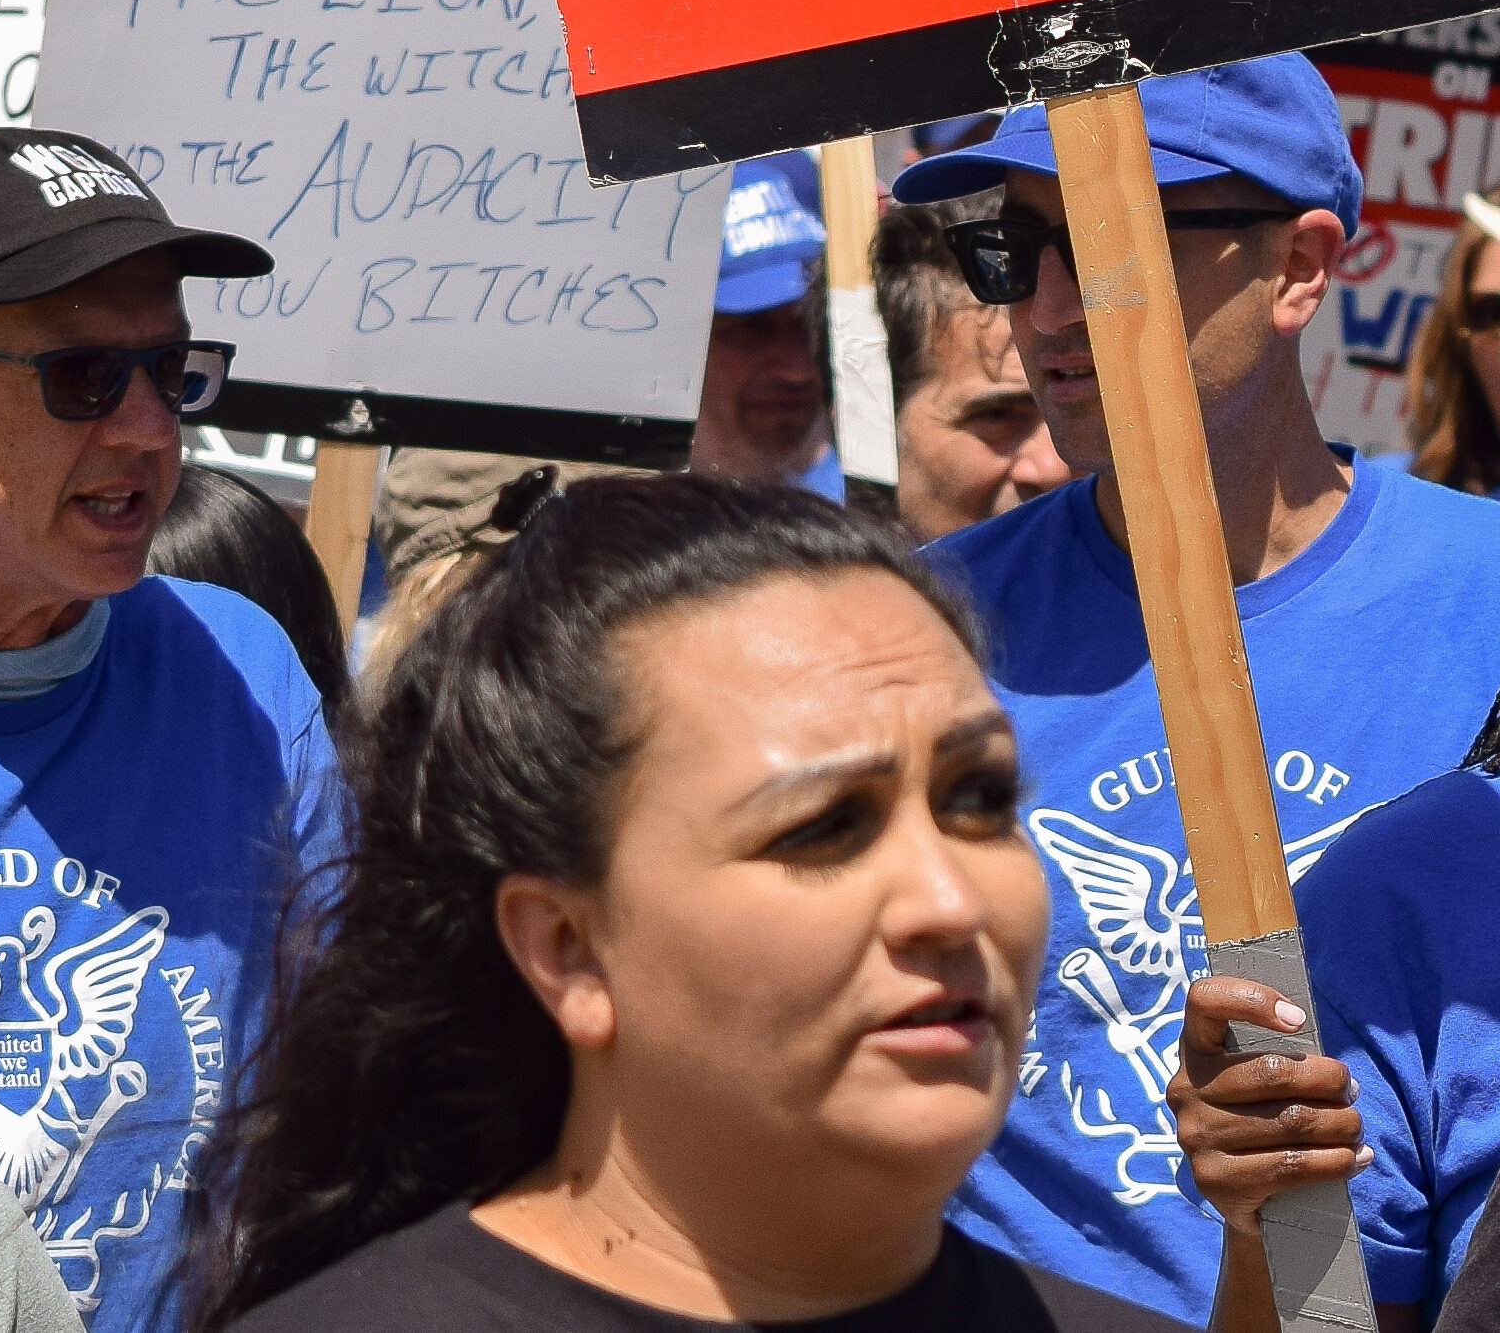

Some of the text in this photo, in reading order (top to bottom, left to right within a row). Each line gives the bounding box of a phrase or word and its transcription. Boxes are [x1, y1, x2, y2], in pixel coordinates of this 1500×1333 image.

[209, 31, 337, 102] THE
[1432, 61, 1492, 101] ON
[181, 141, 274, 185] THE
[354, 256, 667, 333] BITCHES
[1273, 749, 1351, 806] OF
[51, 856, 124, 911] OF
[0, 1056, 29, 1071] we
